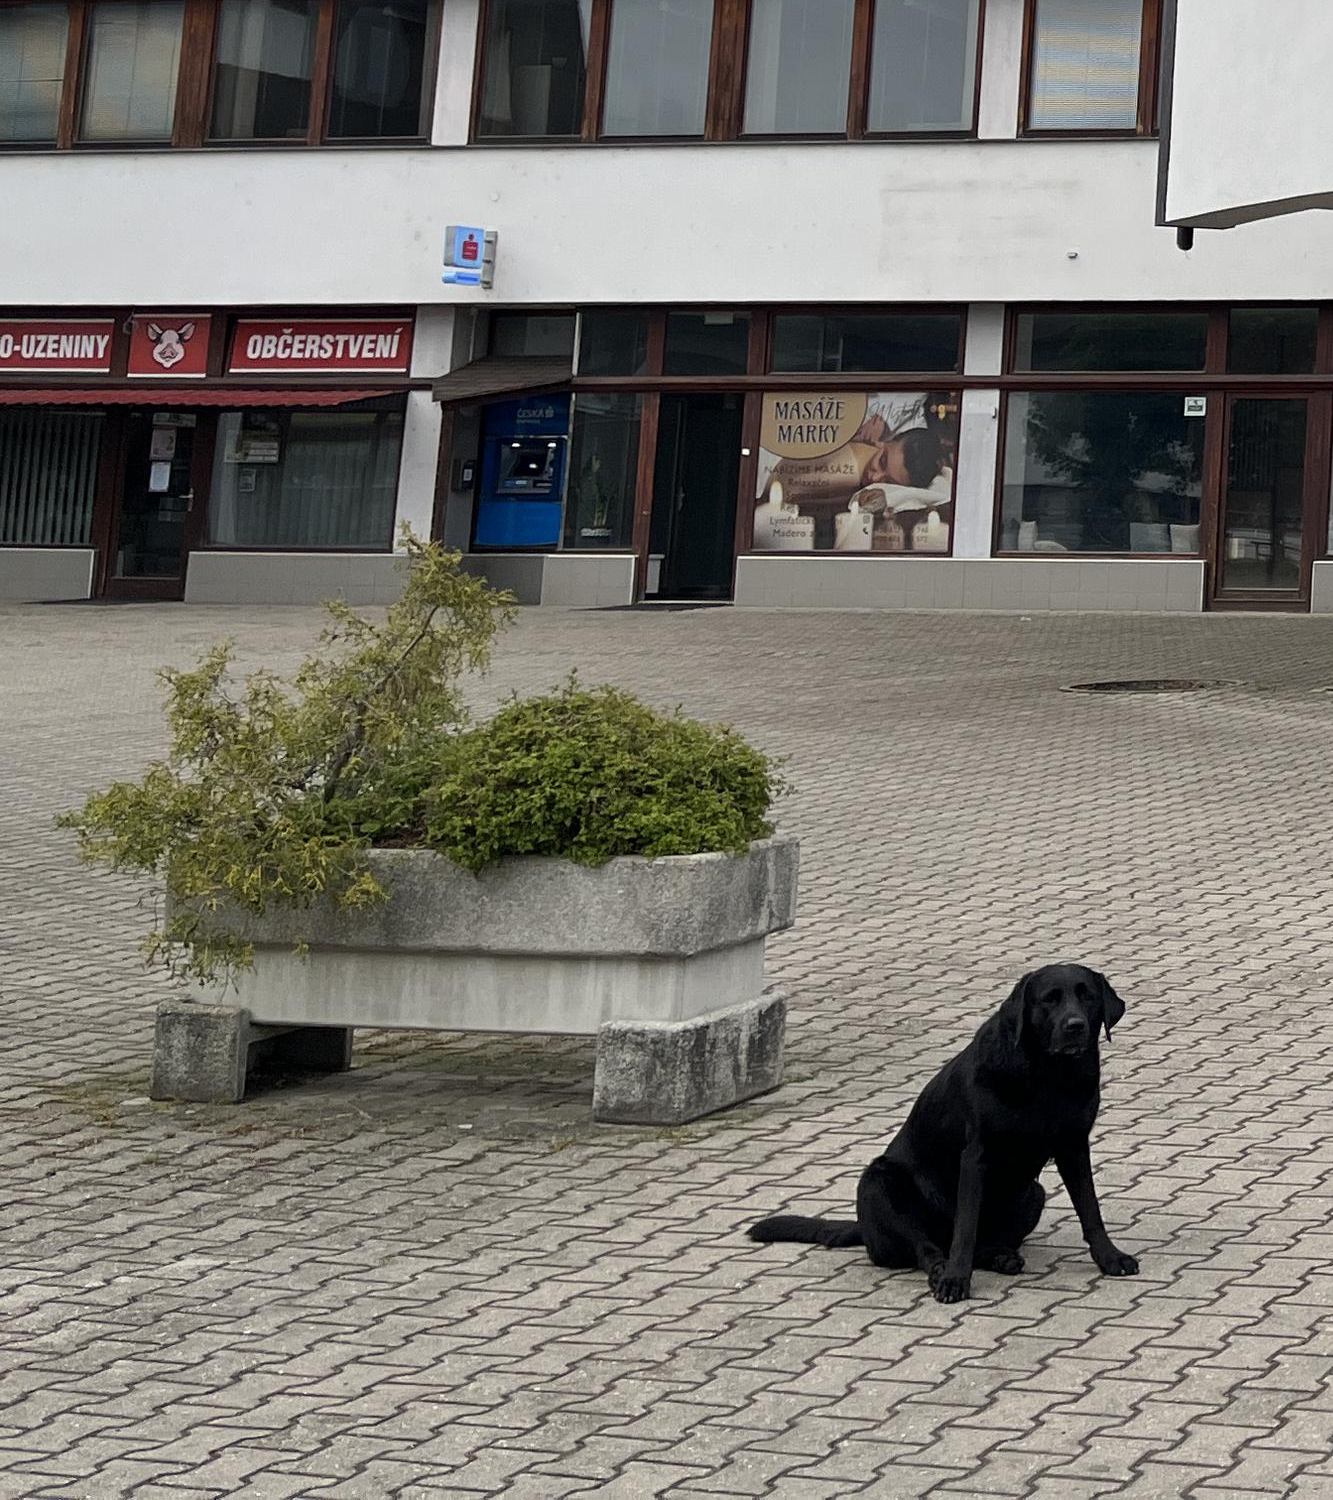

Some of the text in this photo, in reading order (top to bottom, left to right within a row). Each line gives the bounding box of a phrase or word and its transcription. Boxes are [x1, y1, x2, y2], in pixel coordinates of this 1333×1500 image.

[246, 327, 404, 359] OBČERSTVENÍ
[774, 396, 846, 421] MASÁŽE
[777, 424, 840, 444] MARKY
